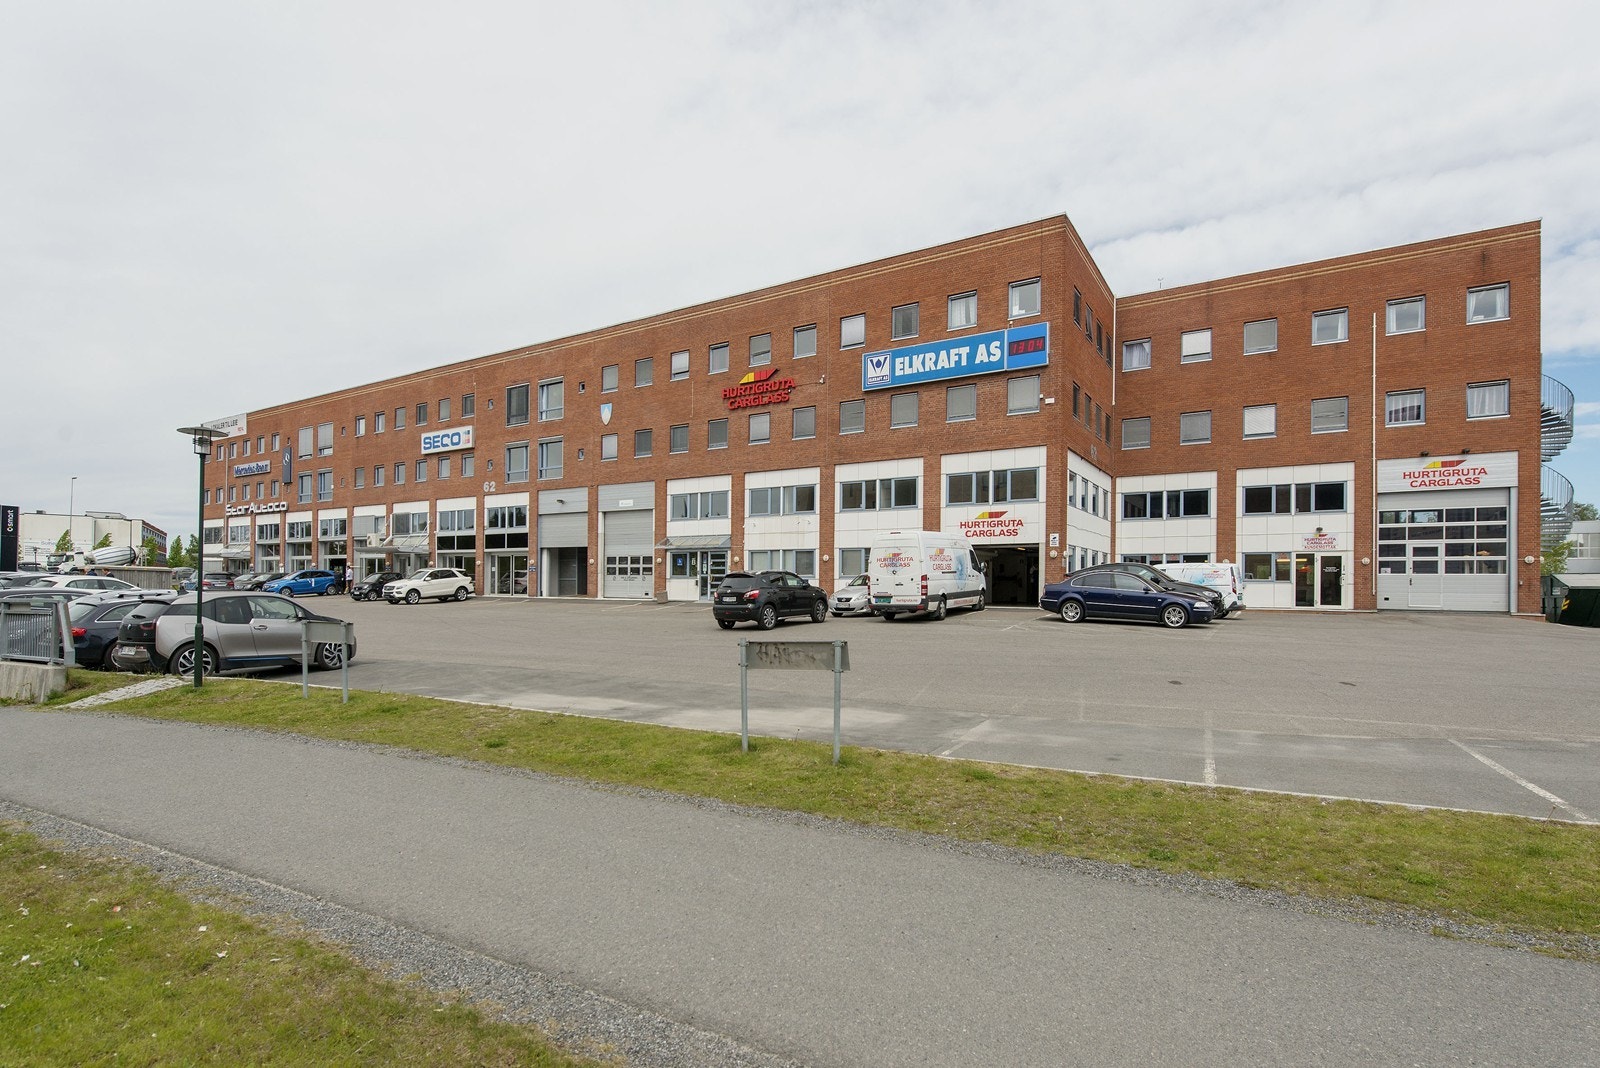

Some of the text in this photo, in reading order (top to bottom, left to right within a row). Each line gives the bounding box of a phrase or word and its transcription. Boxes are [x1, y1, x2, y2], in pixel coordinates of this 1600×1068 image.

[895, 341, 1001, 376] ELKRAFT AS
[721, 377, 796, 399] HURTIGRUTA
[727, 390, 790, 411] CARGLASS
[423, 432, 461, 450] SECO
[1403, 467, 1488, 479] HURTIGRUTA
[483, 481, 496, 492] 62
[1410, 477, 1481, 488] CARGLASS
[960, 519, 1024, 529] HURTIGRUTA
[965, 529, 1019, 538] CARGLASS
[929, 554, 953, 563] HURTIGRUTA
[932, 563, 952, 571] CARGLASS
